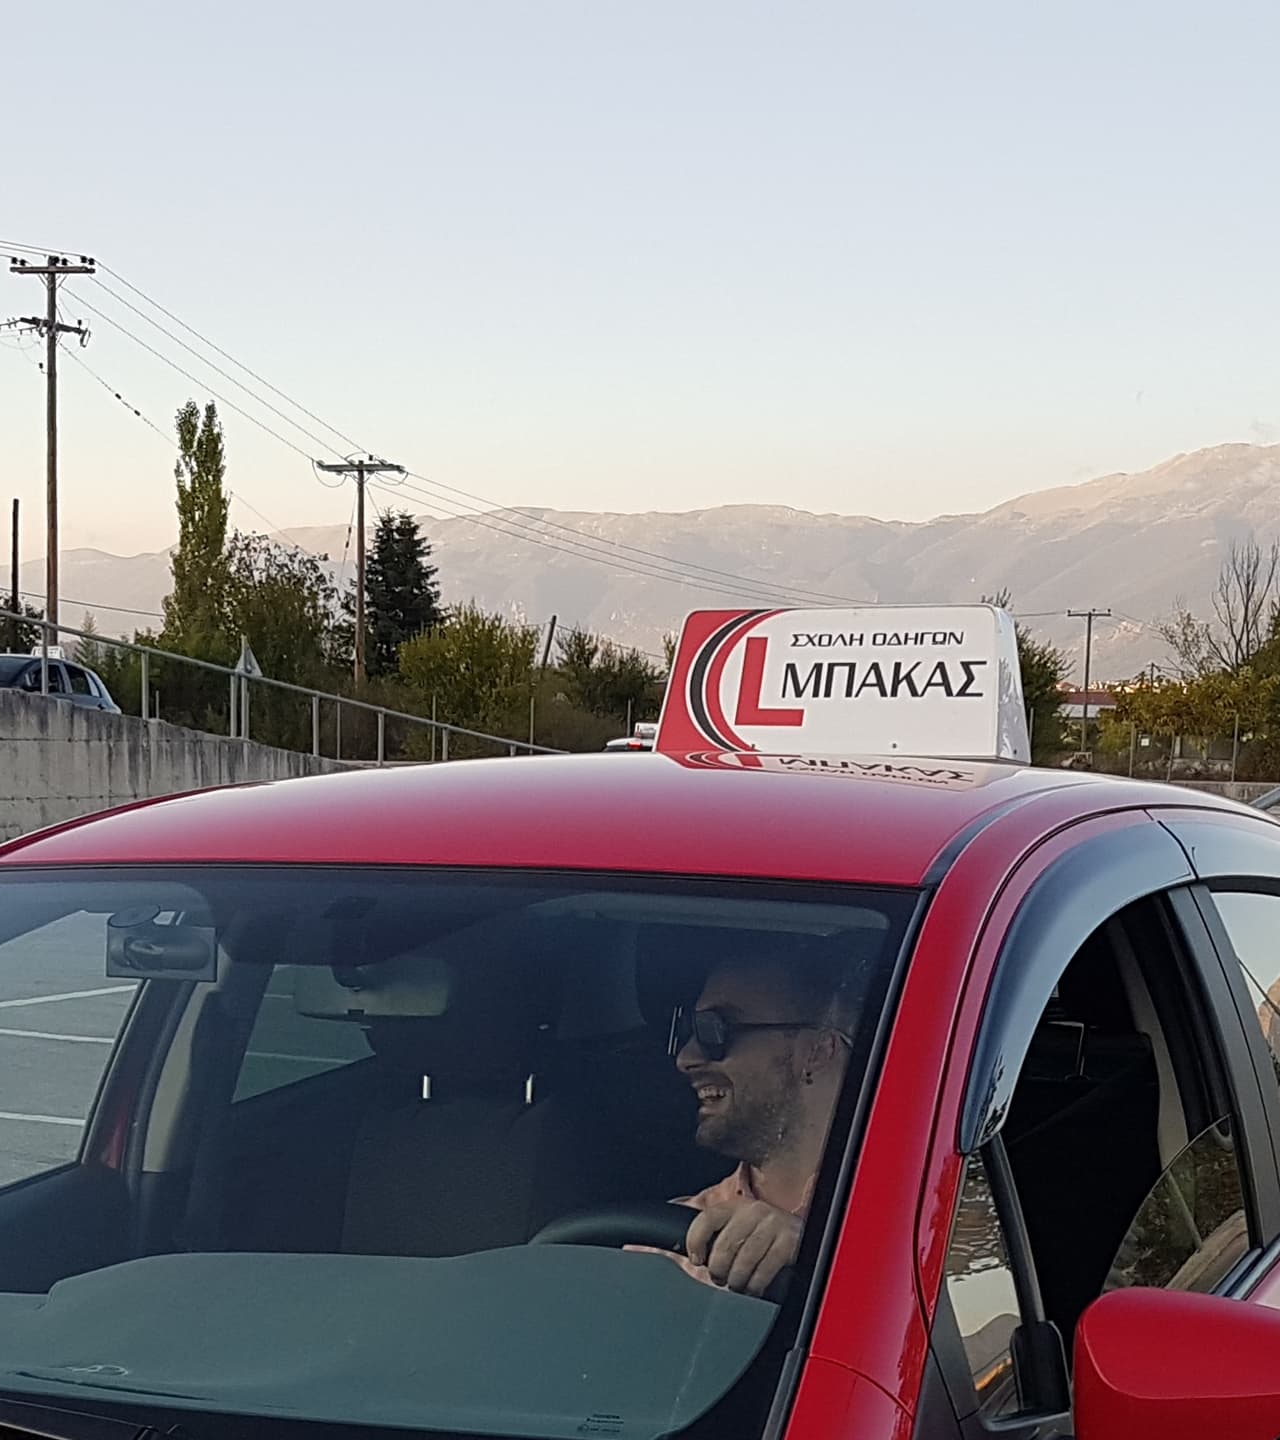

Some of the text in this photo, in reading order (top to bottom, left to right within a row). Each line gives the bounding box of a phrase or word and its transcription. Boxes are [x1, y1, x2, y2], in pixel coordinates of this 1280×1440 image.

[790, 631, 964, 647] ΣΧΟΛΗ ΟΔΗΓΩΝ
[734, 636, 805, 726] L
[781, 660, 987, 699] ΜΠΑΚΑΣ
